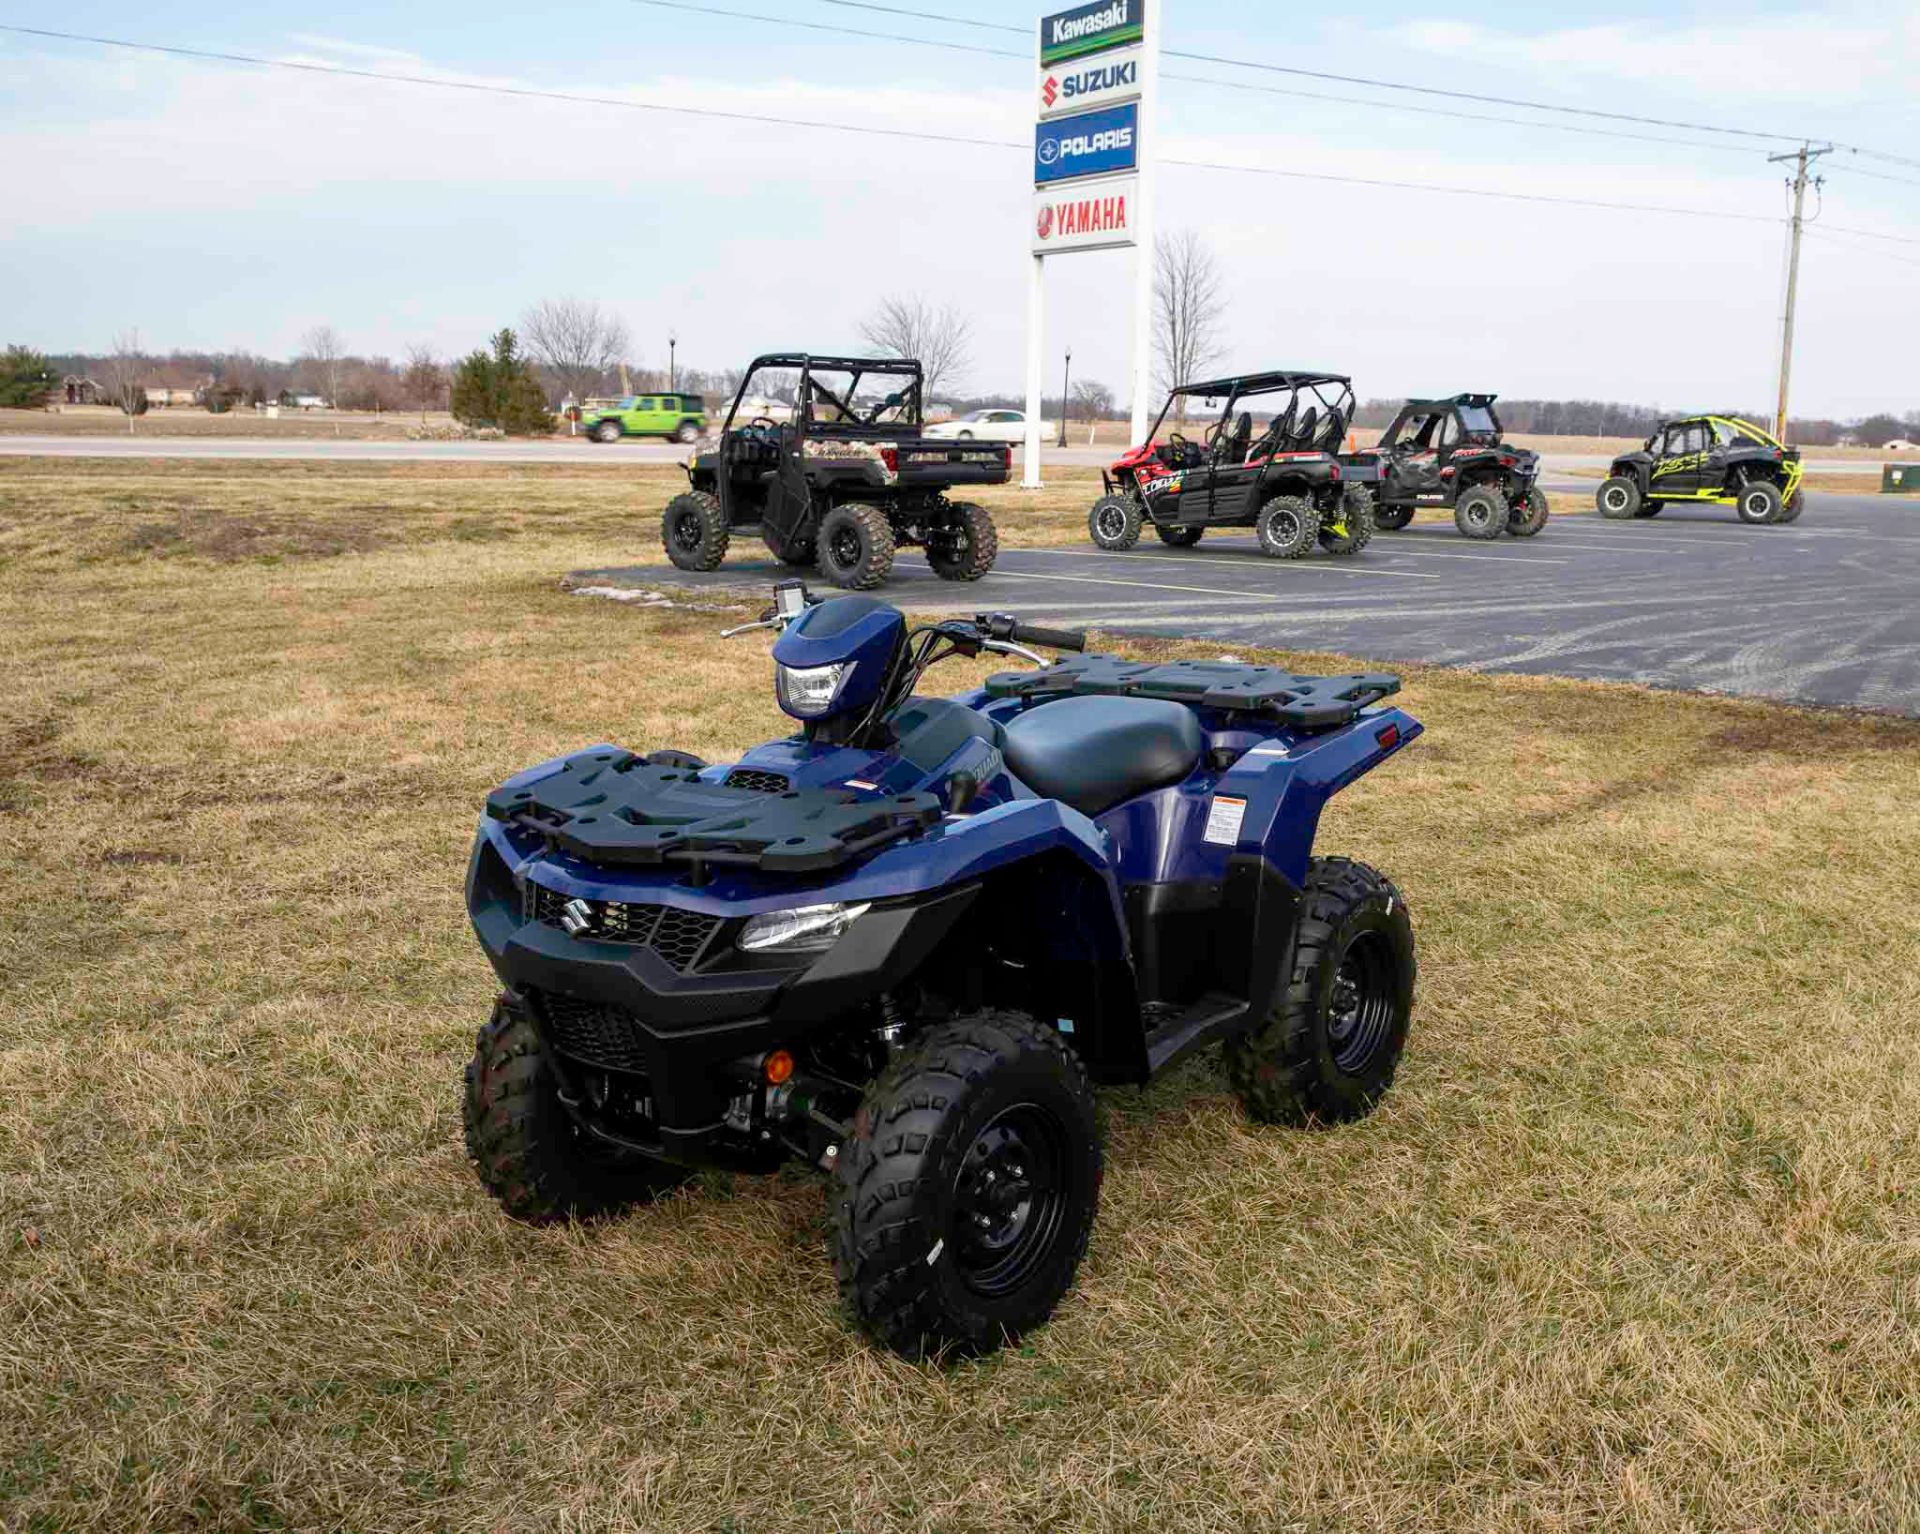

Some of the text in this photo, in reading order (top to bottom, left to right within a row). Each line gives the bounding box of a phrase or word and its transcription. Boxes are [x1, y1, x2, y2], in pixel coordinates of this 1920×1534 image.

[1052, 0, 1128, 44] Kawasaki
[1062, 60, 1136, 98] SUZUKI
[1060, 127, 1133, 158] POLARIS
[1056, 195, 1126, 235] YAMAHA
